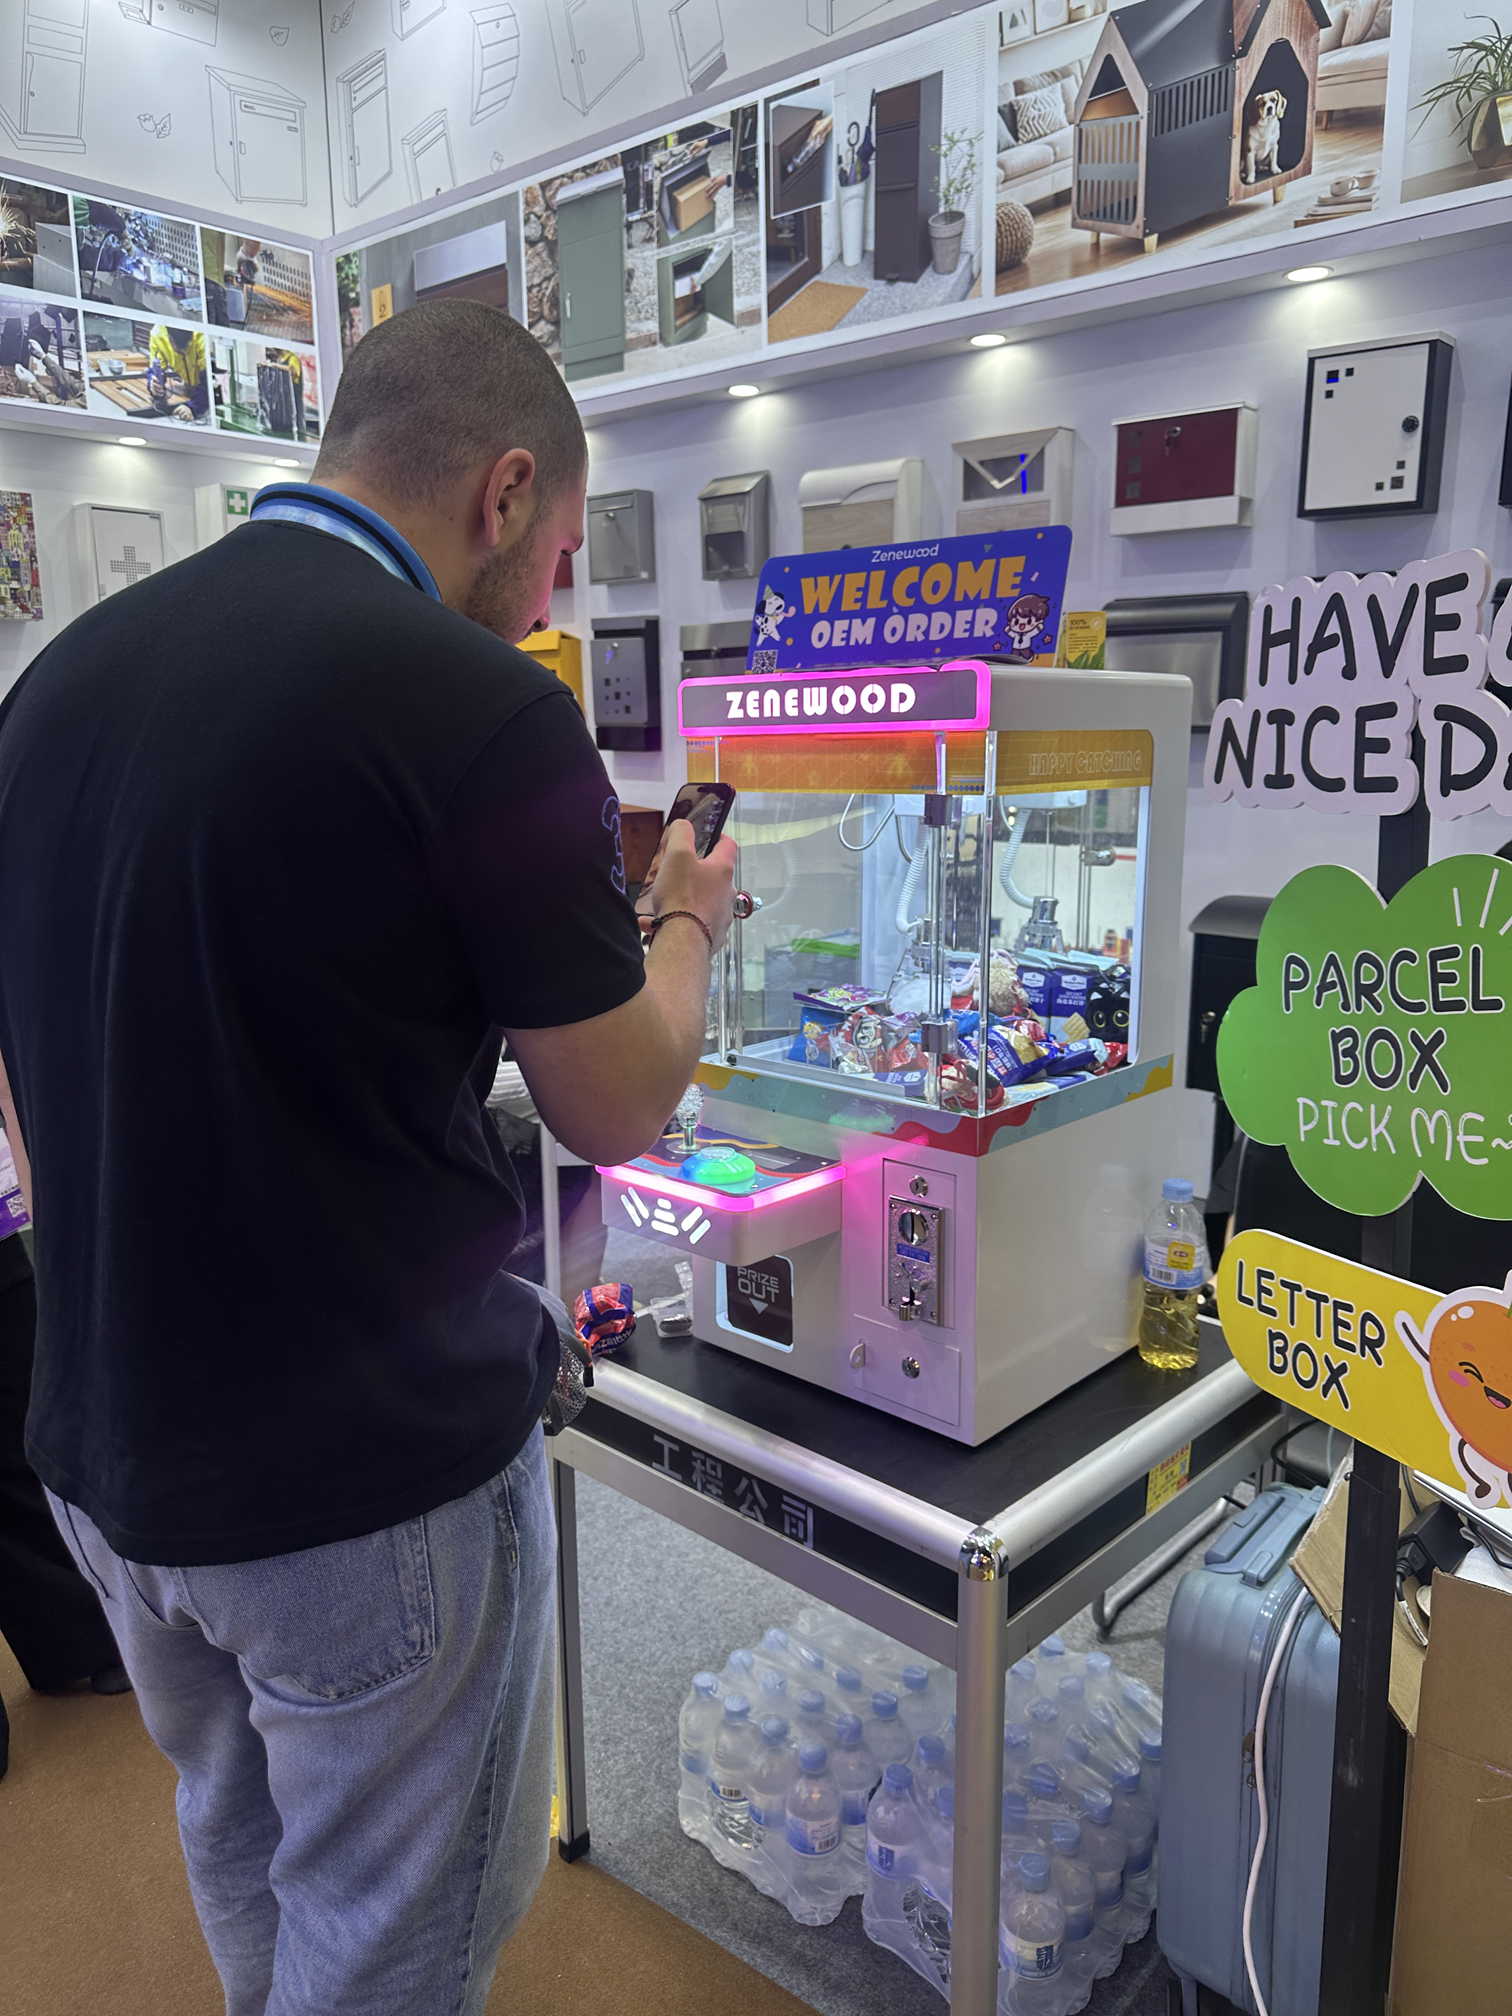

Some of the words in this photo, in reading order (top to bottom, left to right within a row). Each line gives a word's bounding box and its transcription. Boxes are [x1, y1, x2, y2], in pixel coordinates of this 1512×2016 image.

[379, 304, 386, 318] 2
[871, 543, 940, 563] Zenewood
[801, 556, 1026, 615] WELCOME
[811, 618, 875, 649] OEM
[883, 607, 999, 644] ORDER
[1259, 572, 1469, 687] HAVE
[726, 683, 917, 719] ZENEWOOD
[1029, 752, 1075, 776] HAPPY
[1075, 750, 1142, 774] CATCHING
[1214, 701, 1399, 793] NICE
[1433, 704, 1512, 798] D
[1282, 944, 1505, 1015] PARCEL
[1329, 1025, 1451, 1096] BOX
[1297, 1097, 1396, 1154] PICK
[737, 1267, 779, 1288] PRIZE
[738, 1278, 780, 1303] OUT
[1237, 1259, 1386, 1368] LETTER
[1267, 1328, 1349, 1411] BOX
[652, 1434, 814, 1550] 工程公司
